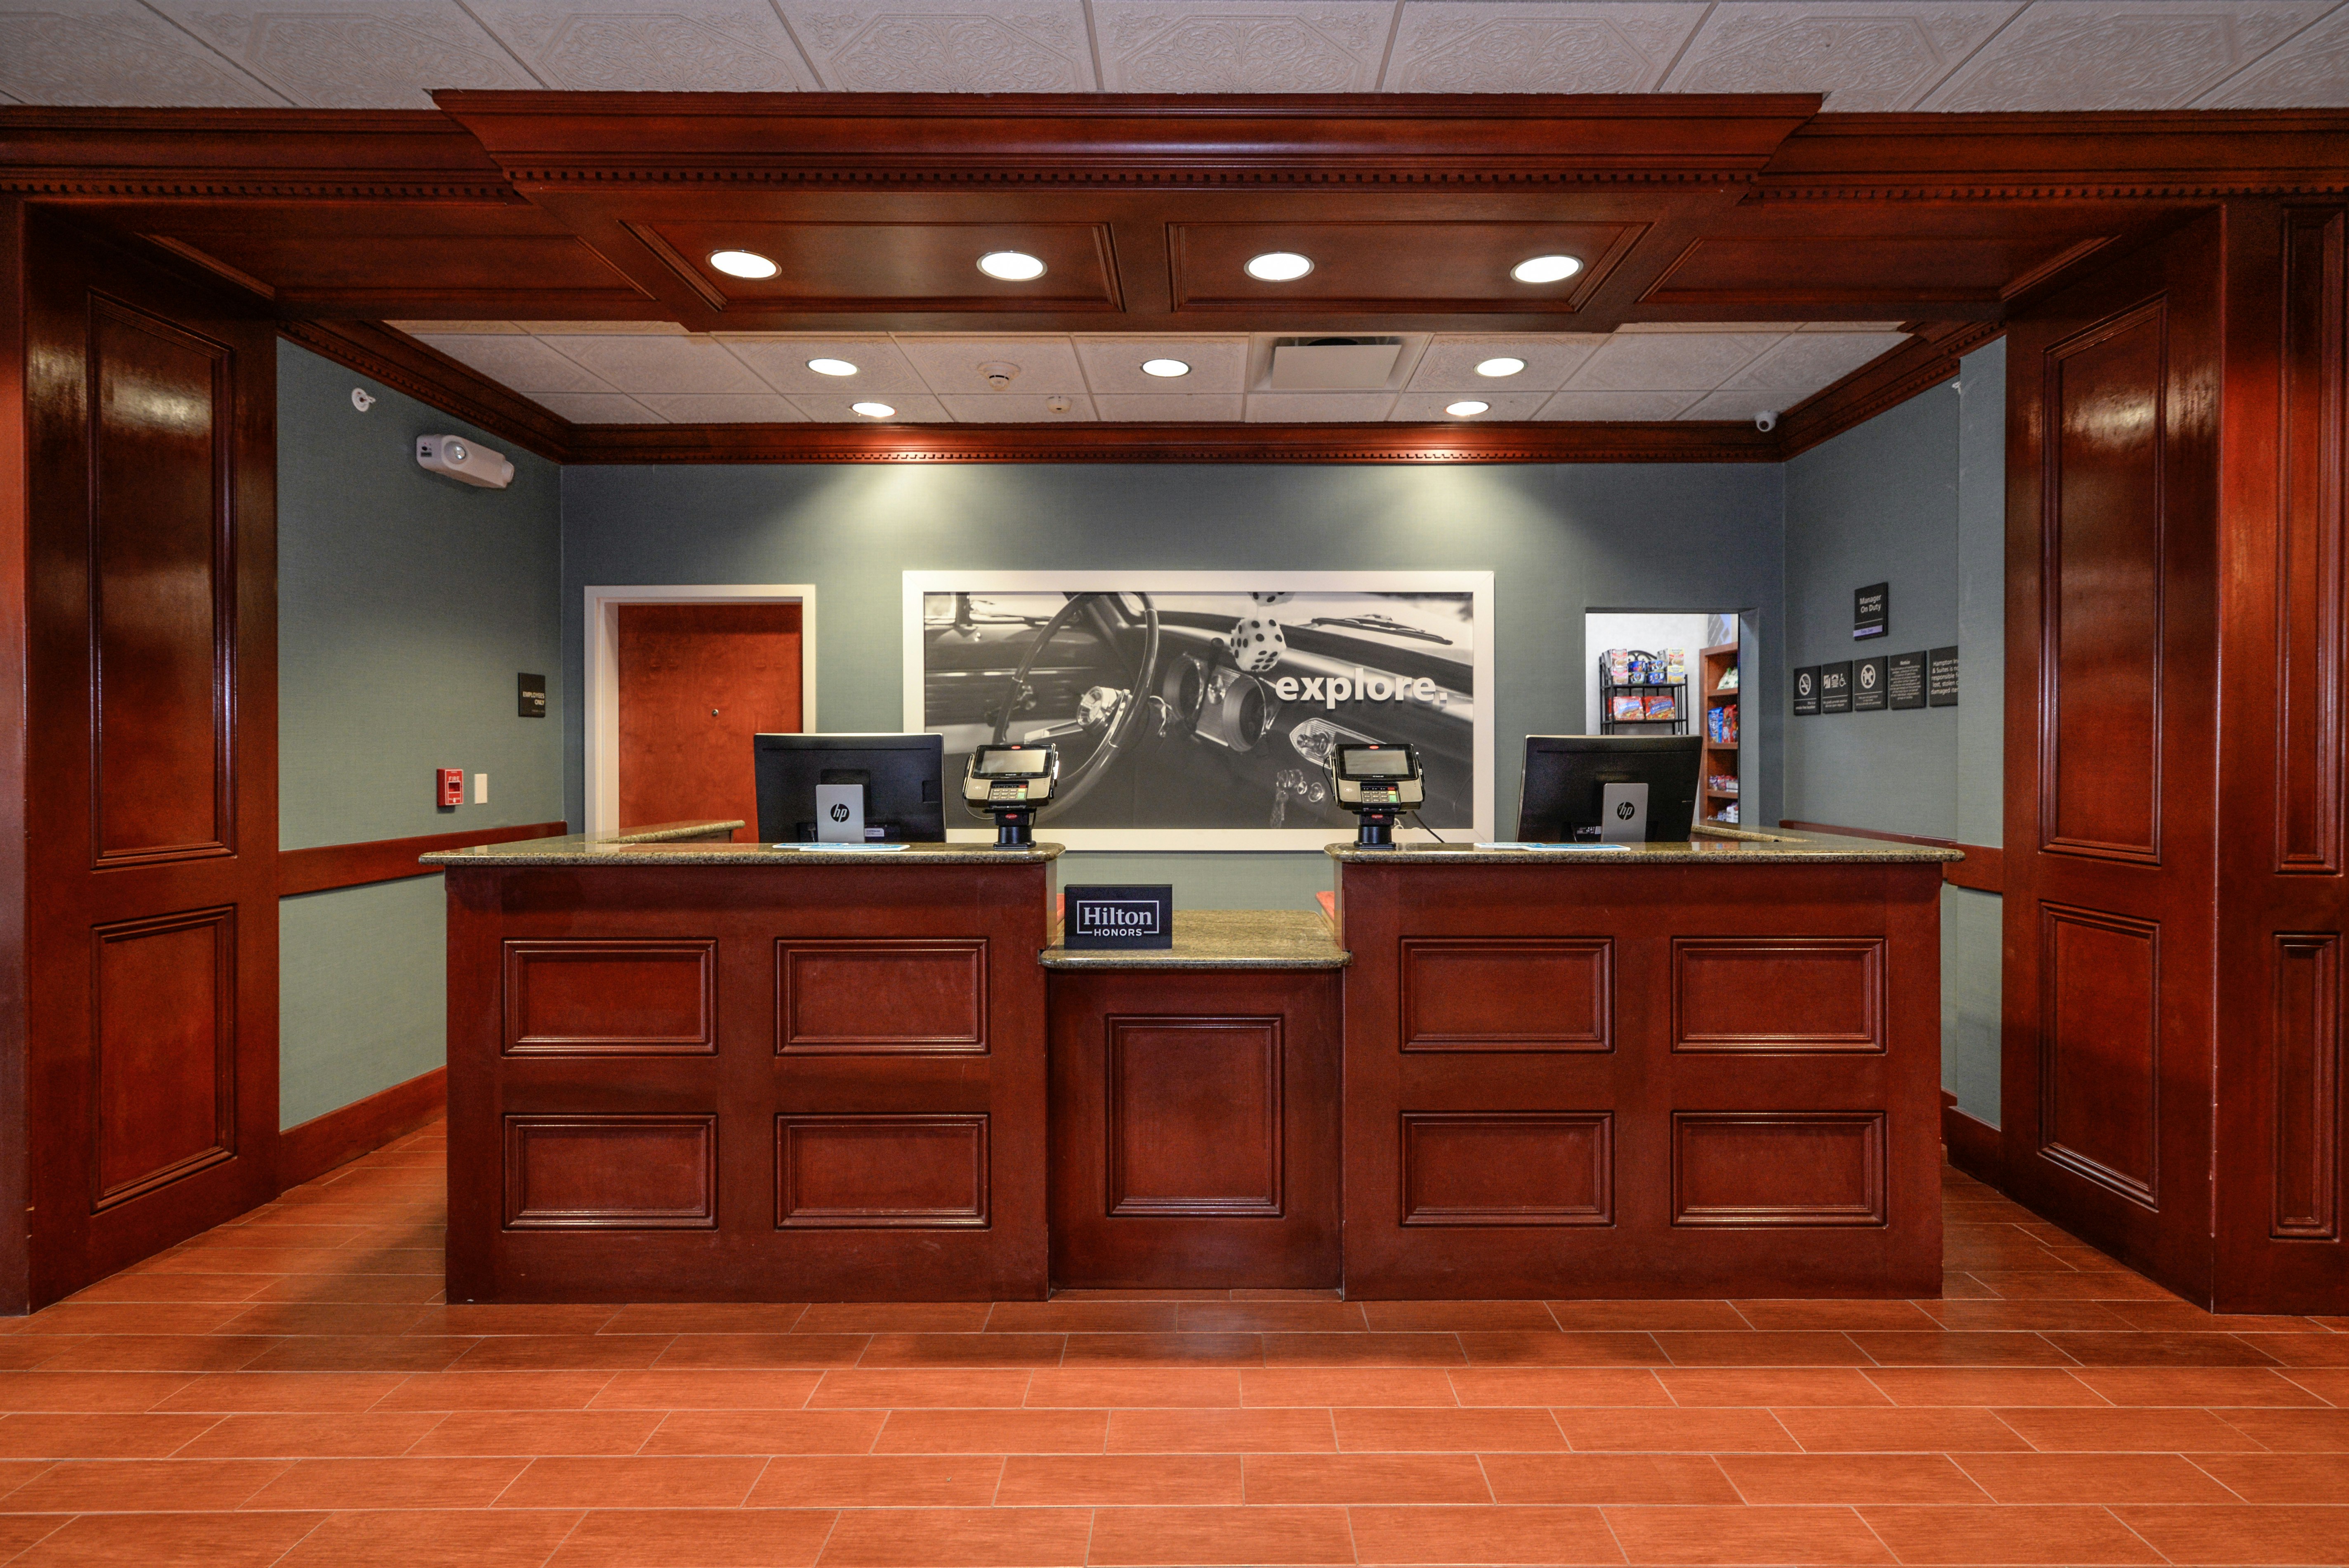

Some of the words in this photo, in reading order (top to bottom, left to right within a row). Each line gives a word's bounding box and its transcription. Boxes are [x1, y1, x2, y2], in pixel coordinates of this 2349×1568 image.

[1860, 595, 1882, 605] Manager
[1276, 668, 1447, 709] explore.
[832, 804, 848, 823] hp
[1619, 802, 1633, 820] hp
[1084, 908, 1152, 925] Hilton
